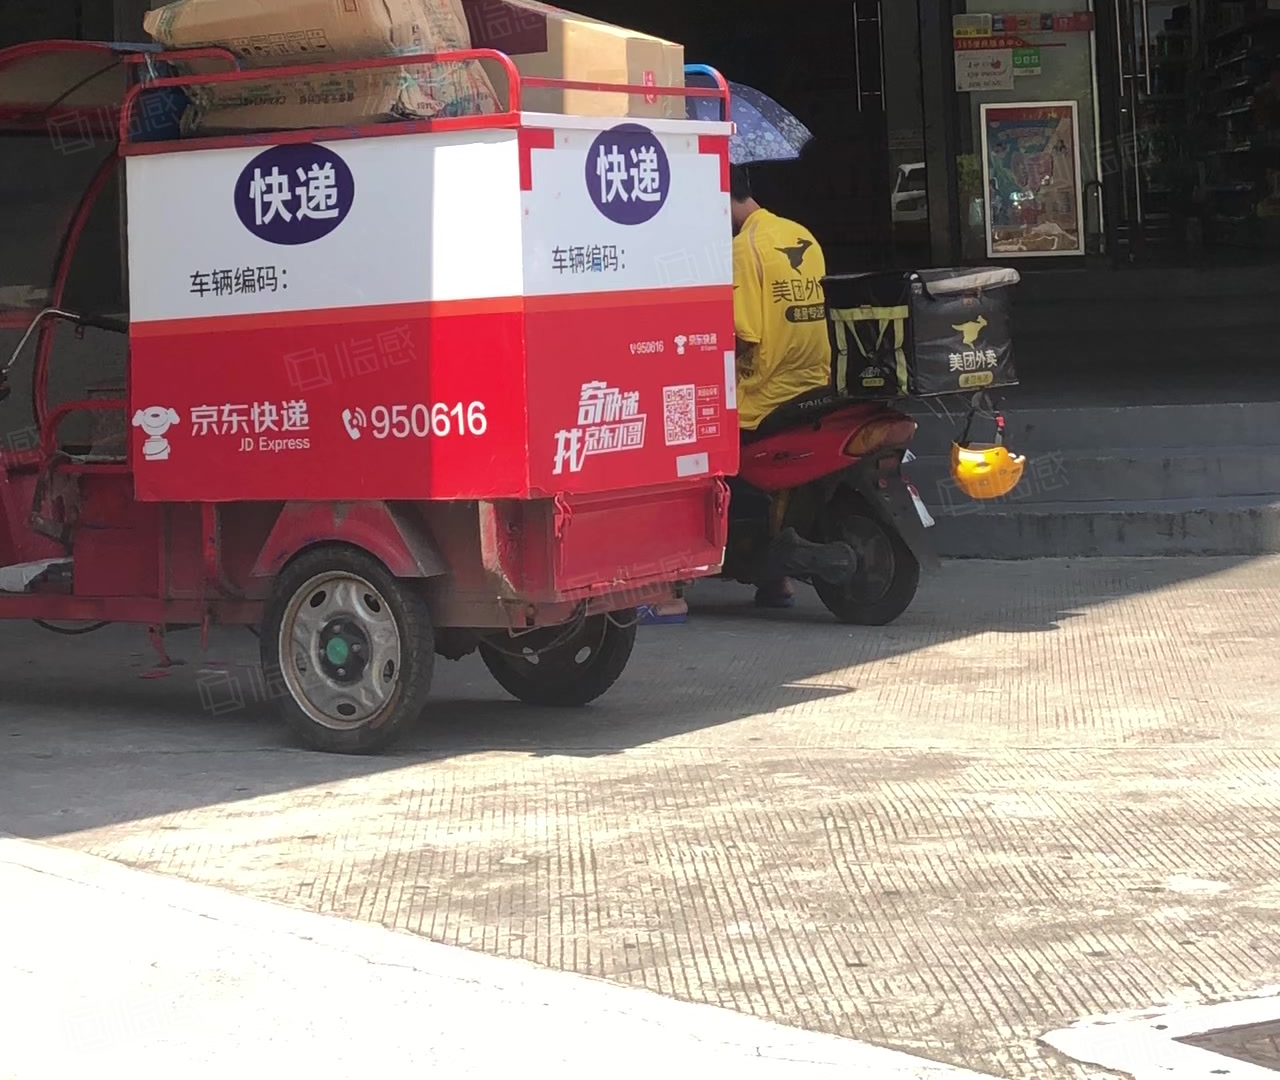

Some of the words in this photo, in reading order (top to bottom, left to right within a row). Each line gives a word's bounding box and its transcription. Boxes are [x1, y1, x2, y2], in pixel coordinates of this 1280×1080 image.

[596, 144, 661, 204] 快递
[249, 161, 340, 226] 快递
[949, 349, 998, 373] 美团外卖
[189, 399, 310, 437] 京东快递
[371, 400, 488, 439] 950616
[238, 437, 254, 452] JD
[259, 436, 310, 452] Express
